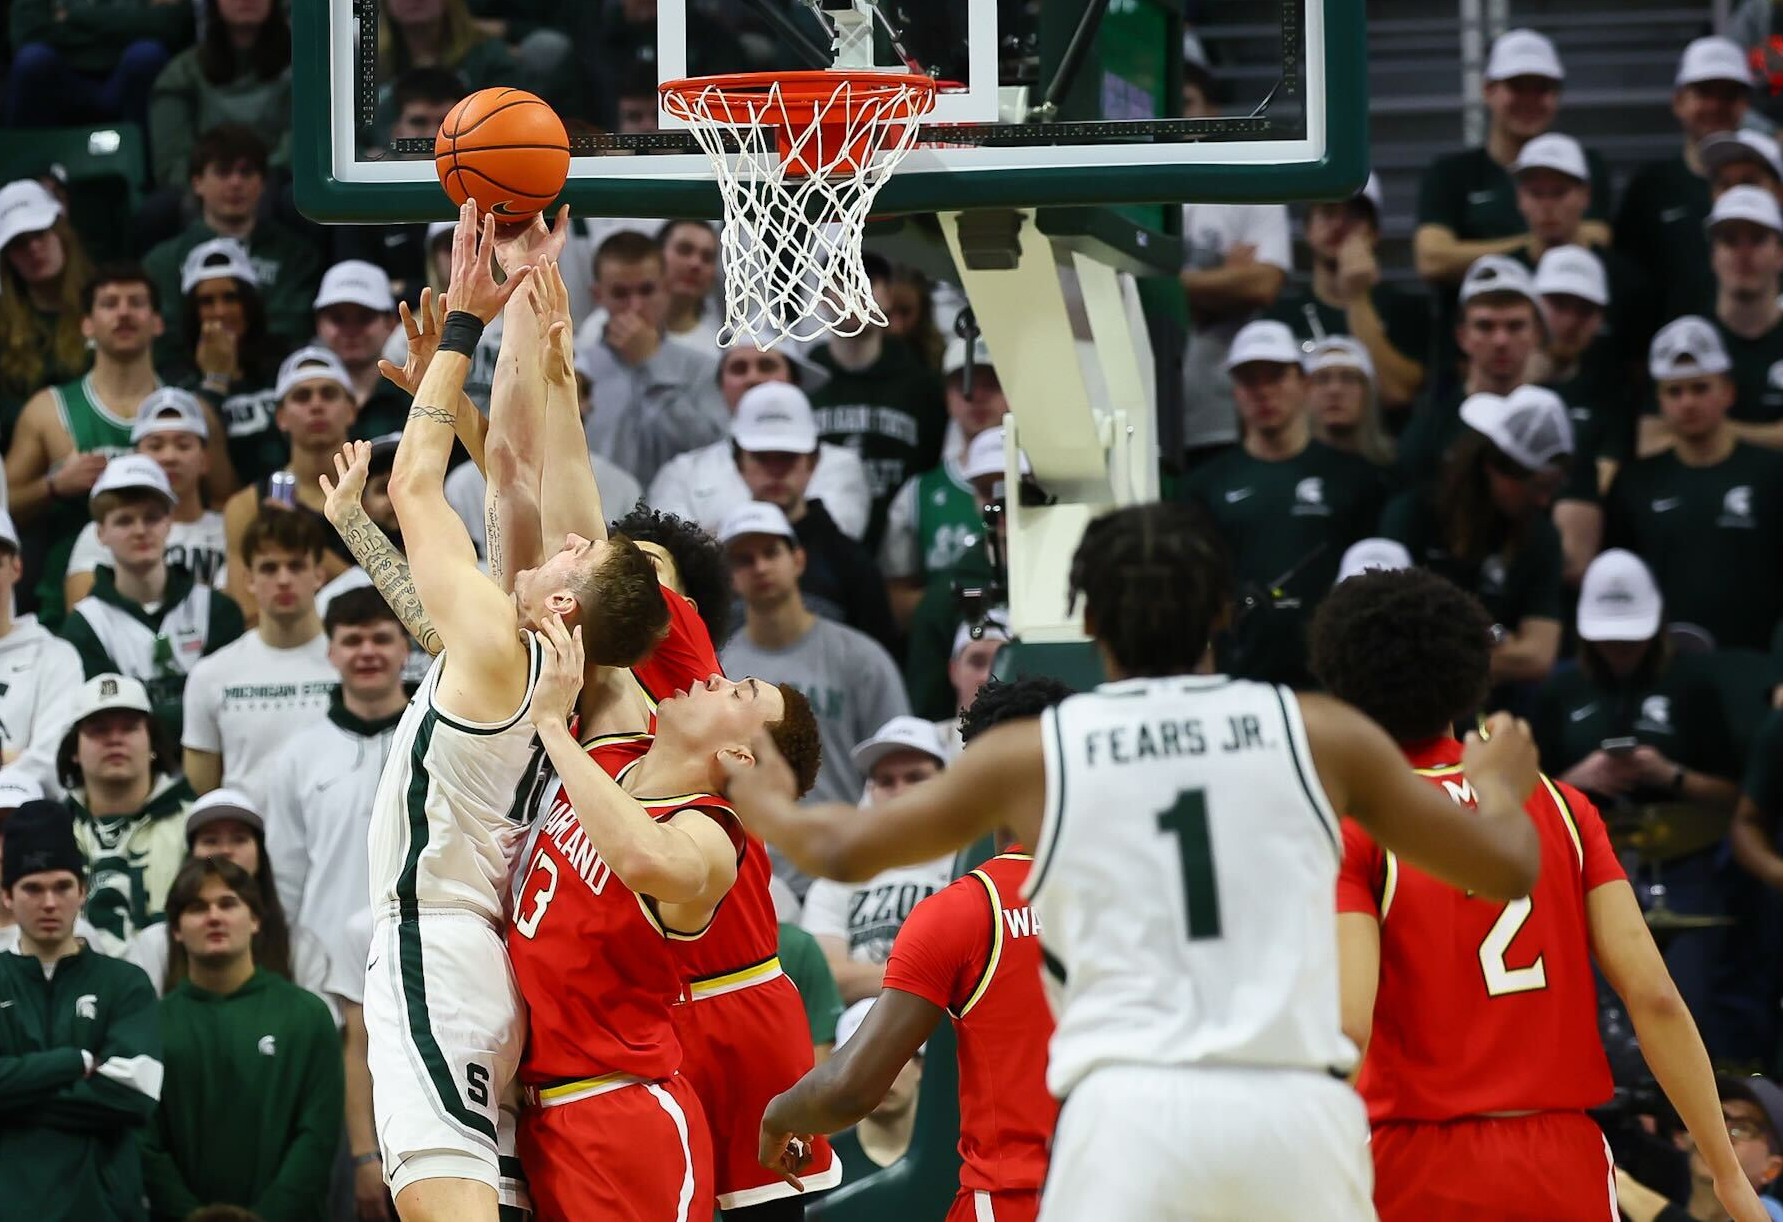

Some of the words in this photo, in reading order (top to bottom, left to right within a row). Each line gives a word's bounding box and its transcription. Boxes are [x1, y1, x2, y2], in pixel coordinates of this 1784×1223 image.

[1085, 719, 1207, 768] FEARS
[1221, 714, 1277, 753] JR.
[1156, 786, 1224, 942] 1
[466, 1062, 490, 1108] S
